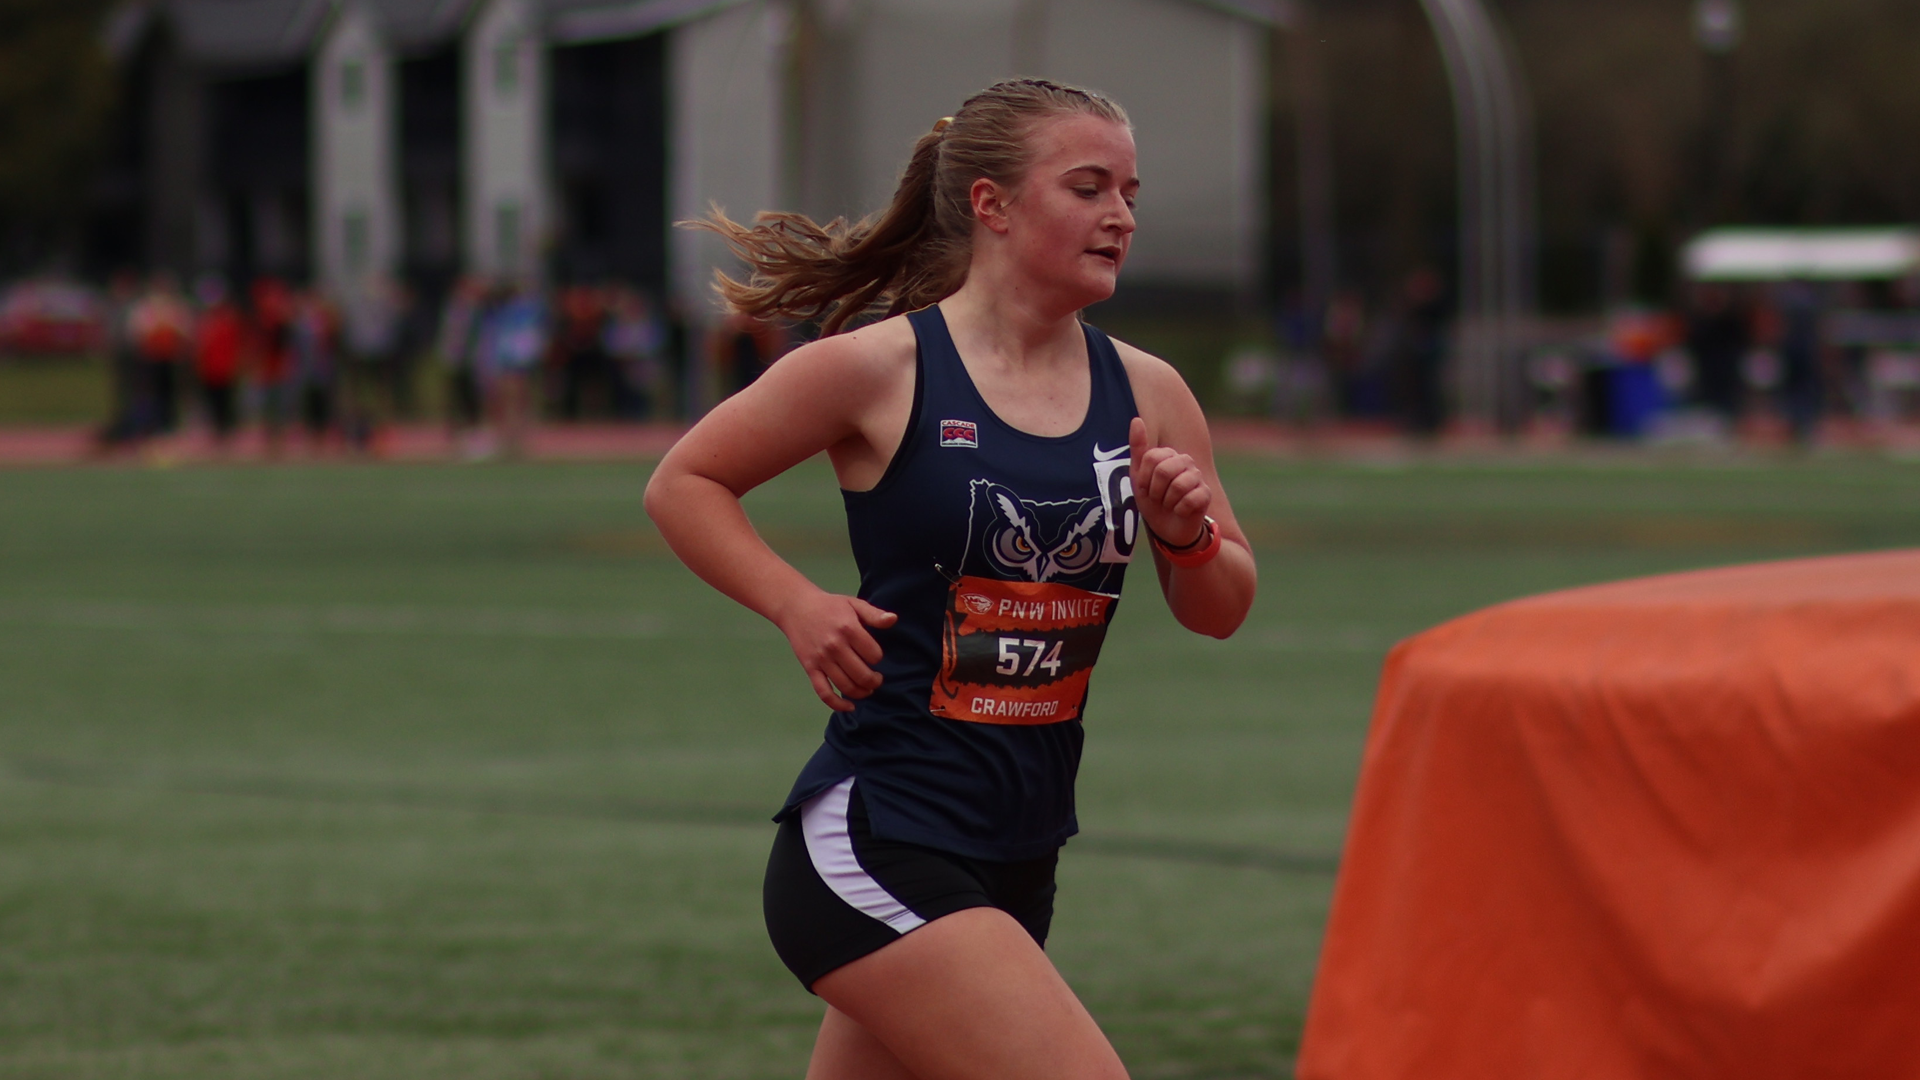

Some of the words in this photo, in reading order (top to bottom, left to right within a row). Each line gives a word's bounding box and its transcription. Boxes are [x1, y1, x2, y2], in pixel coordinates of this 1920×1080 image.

[943, 427, 975, 441] CCC
[1108, 465, 1139, 556] 6
[998, 599, 1045, 620] PNW
[1051, 599, 1102, 620] INVITE
[996, 636, 1064, 677] 574
[971, 697, 1059, 718] CRAWFORD
